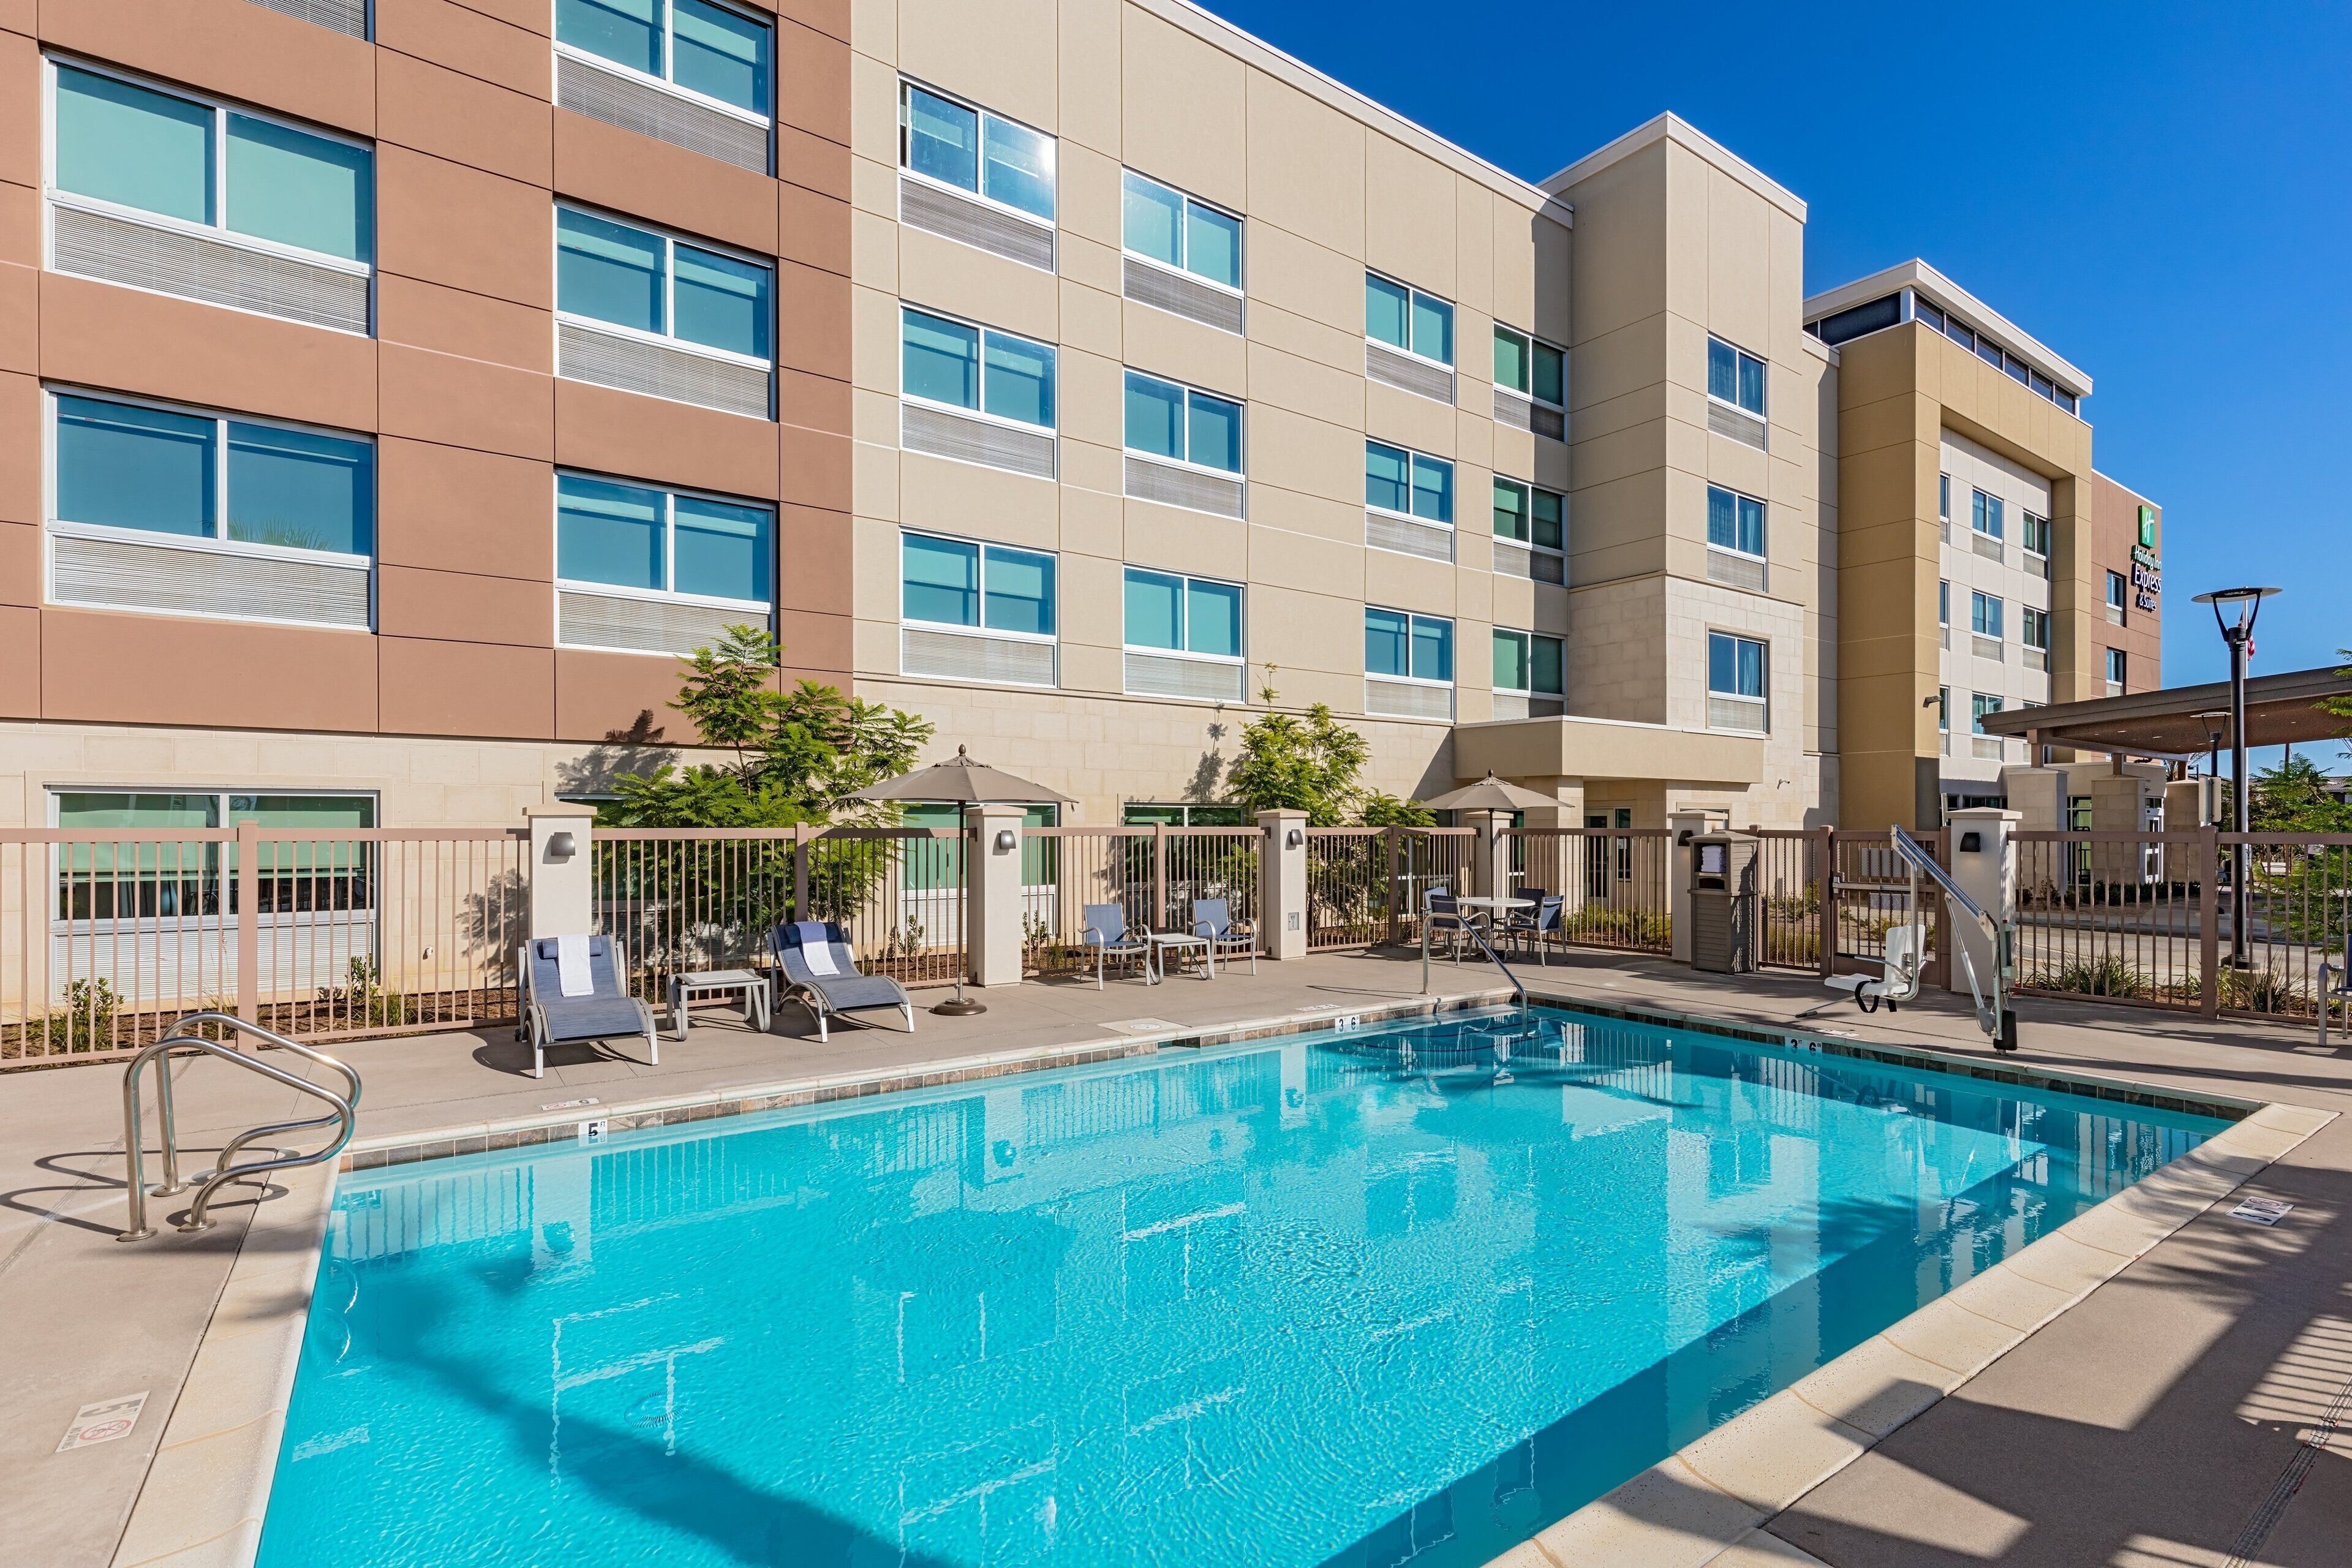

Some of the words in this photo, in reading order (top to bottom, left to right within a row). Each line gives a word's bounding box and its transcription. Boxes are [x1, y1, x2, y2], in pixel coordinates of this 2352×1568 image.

[2135, 545, 2154, 570] Holiday
[2135, 563, 2162, 593] Express
[2139, 594, 2144, 606] &
[2144, 595, 2157, 611] Suites
[588, 1123, 598, 1137] 5
[2233, 1212, 2272, 1221] 3
[80, 1398, 143, 1418] 5
